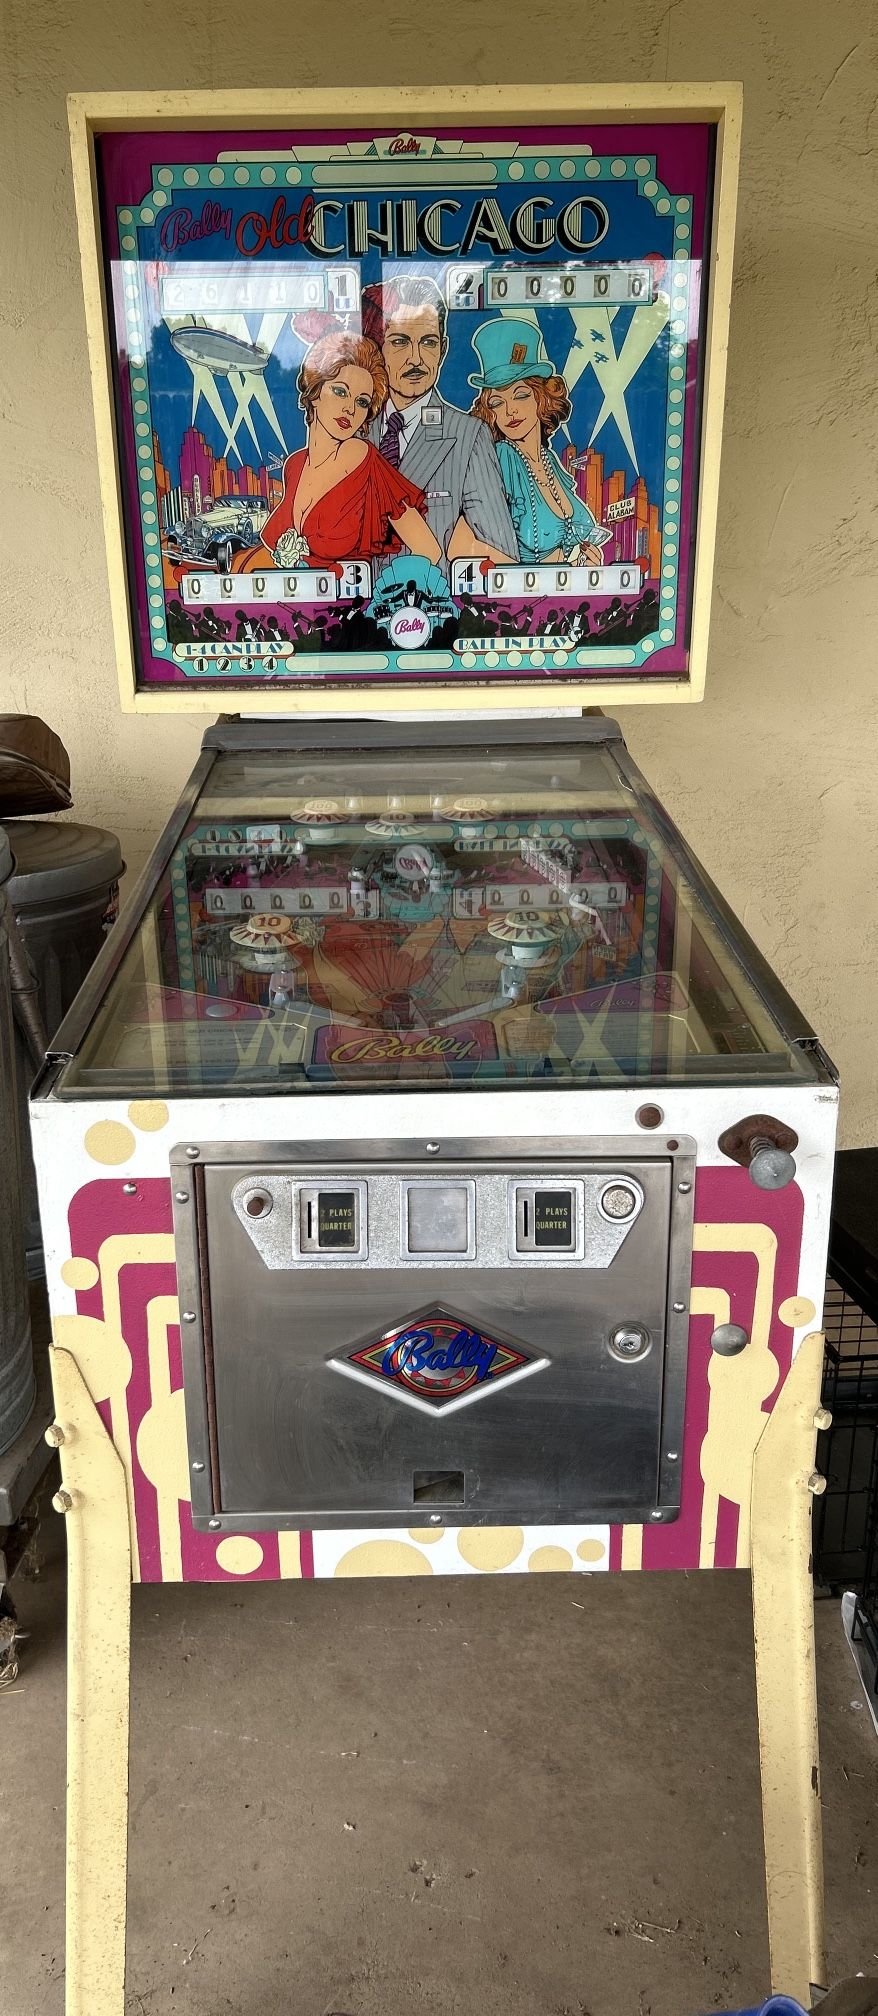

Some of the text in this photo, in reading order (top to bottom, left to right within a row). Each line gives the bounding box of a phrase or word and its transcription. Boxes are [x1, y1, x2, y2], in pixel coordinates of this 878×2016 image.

[388, 137, 421, 156] Bally
[160, 195, 609, 259] Bally Old CHICAGO
[335, 275, 347, 297] 1
[456, 272, 474, 294] 2
[609, 500, 632, 512] CLUB
[345, 564, 363, 585] 3
[457, 563, 476, 583] 4
[395, 618, 425, 635] Bally
[186, 643, 285, 655] 1-4 CAN PLAY
[458, 636, 569, 651] BALL IN PLAY
[195, 656, 275, 671] 1 2 3 4
[257, 916, 282, 927] 10
[514, 911, 540, 922] 10
[330, 1035, 478, 1064] Bally
[329, 1208, 352, 1217] PLAYS
[545, 1208, 568, 1216] PLAYS
[320, 1222, 352, 1231] QUARTER
[535, 1221, 567, 1230] QUARTER
[382, 1329, 498, 1380] Bally
